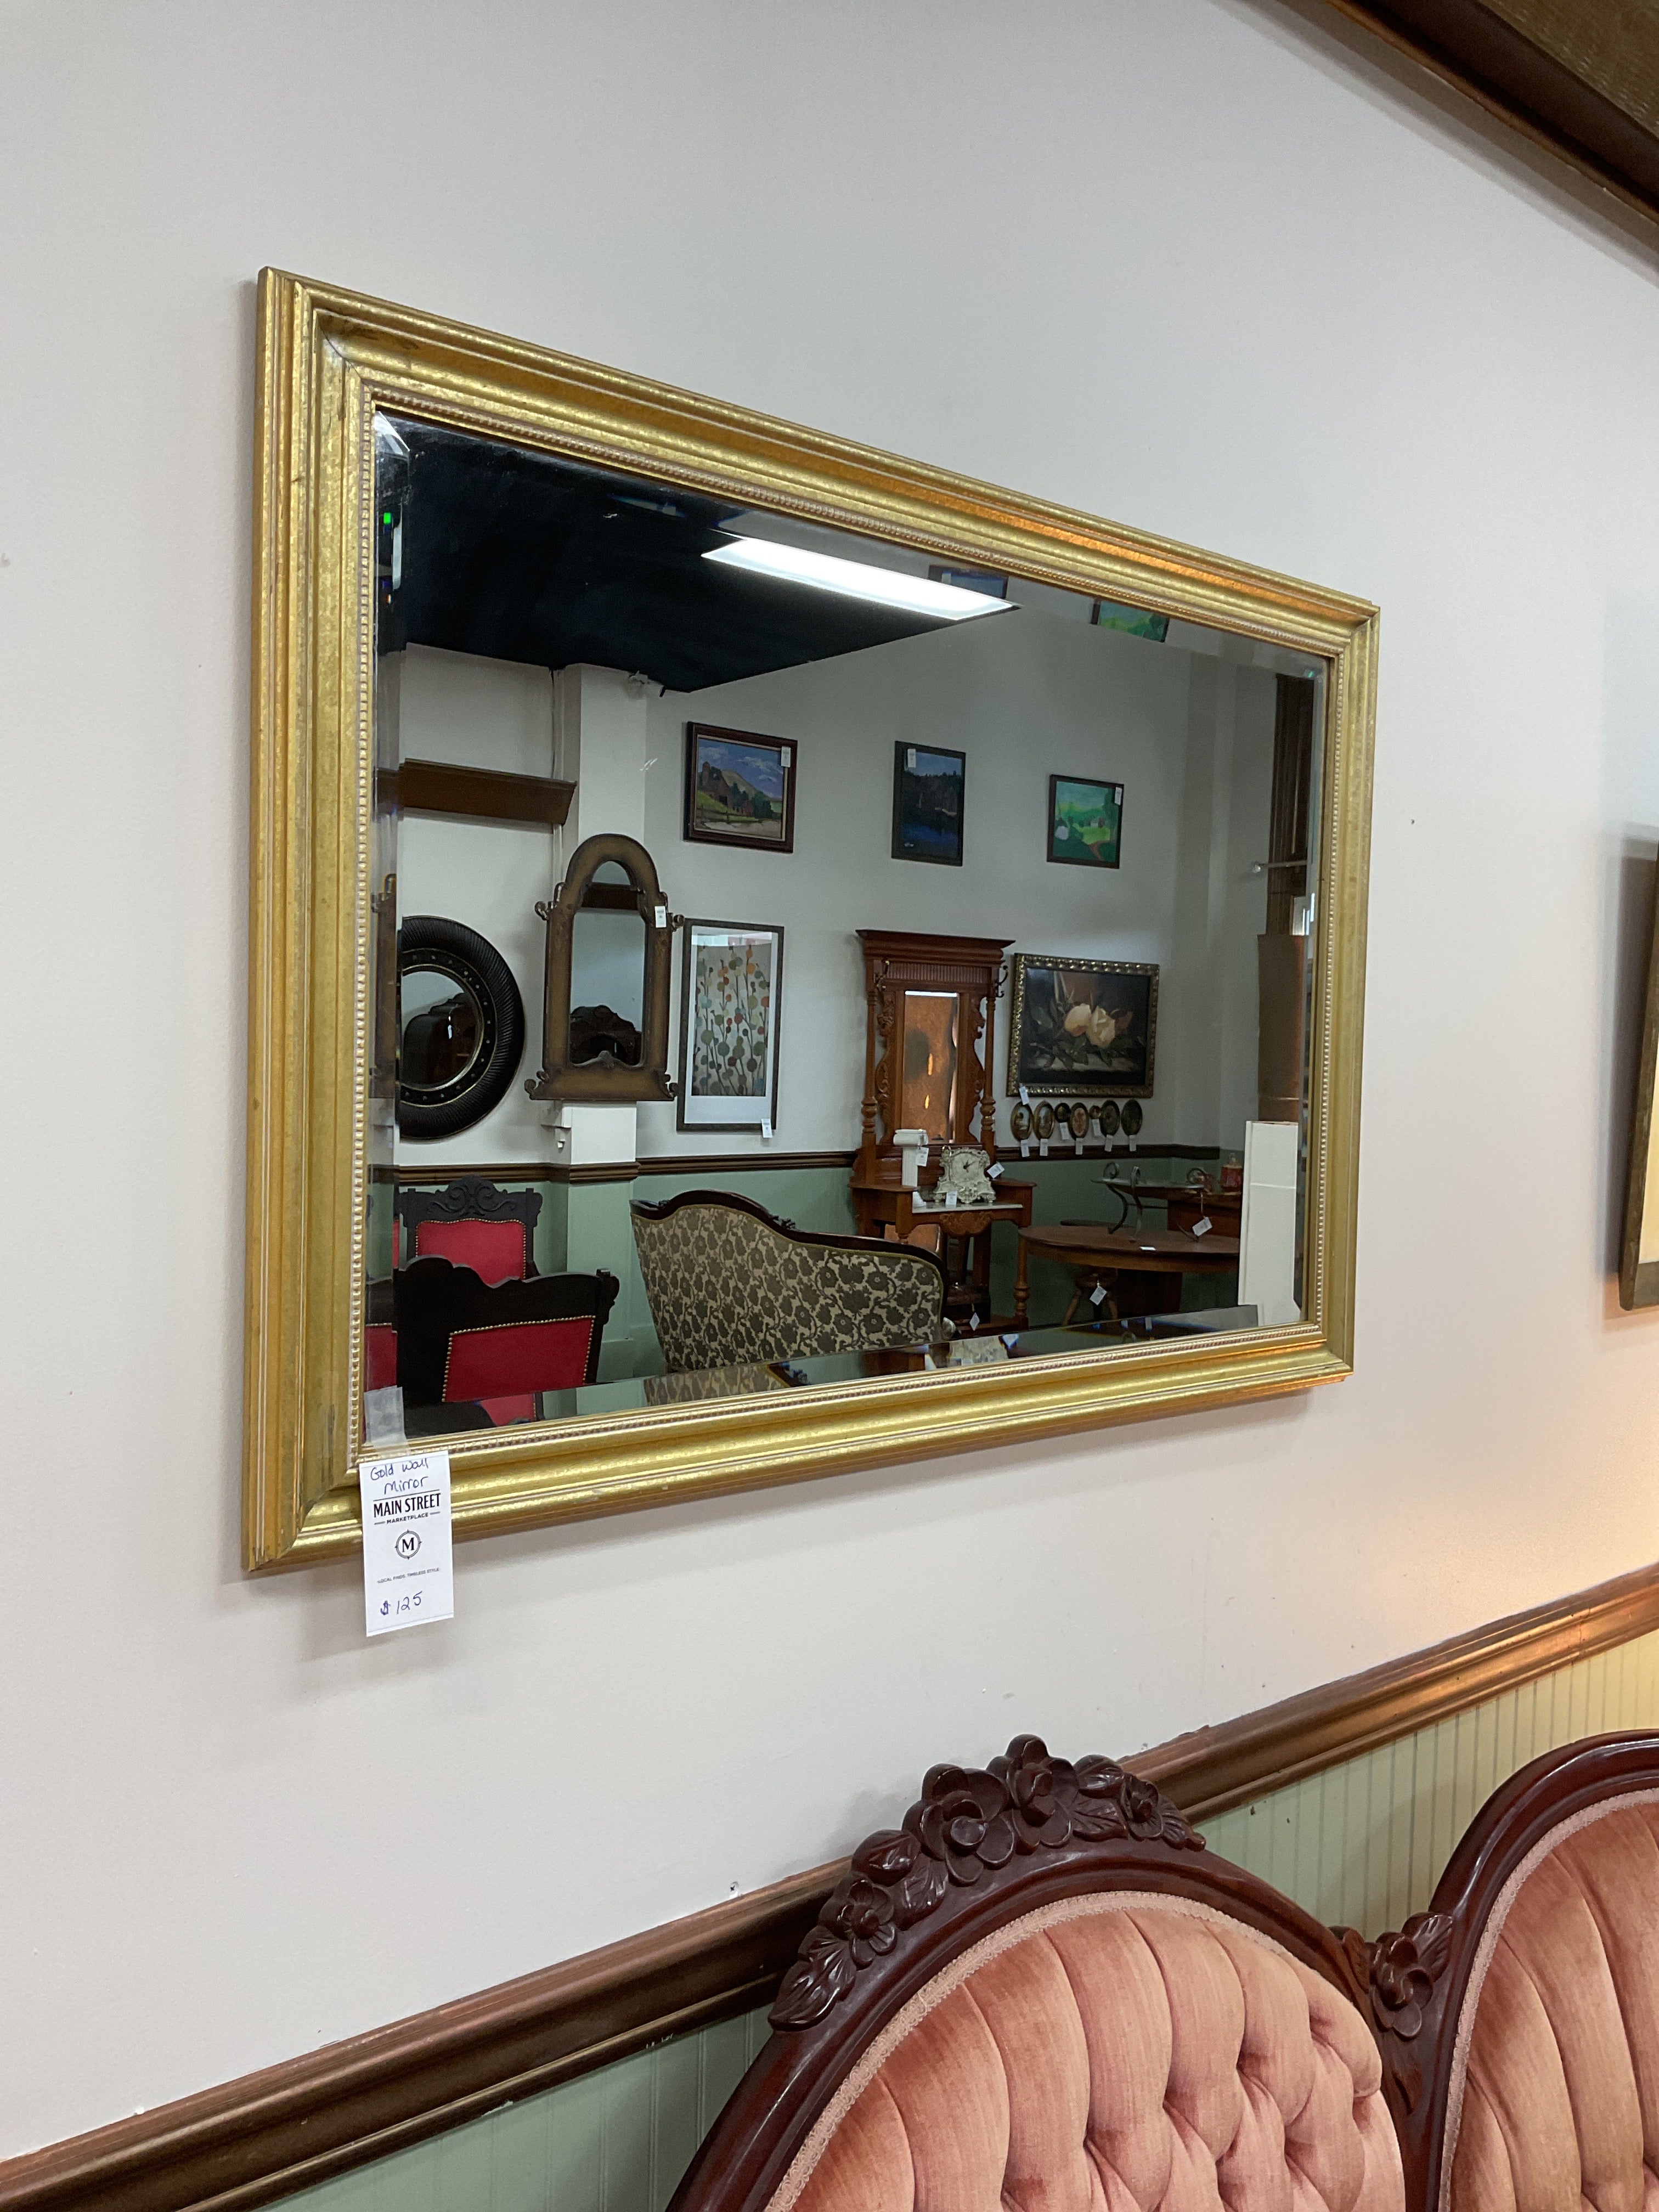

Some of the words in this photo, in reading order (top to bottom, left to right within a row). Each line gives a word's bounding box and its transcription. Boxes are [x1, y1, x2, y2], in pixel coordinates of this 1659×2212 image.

[371, 1464, 393, 1481] Gold
[374, 1500, 402, 1517] MAIN
[405, 1493, 441, 1513] STREET
[387, 1513, 428, 1524] MARKETPLACE
[402, 1537, 415, 1552] M
